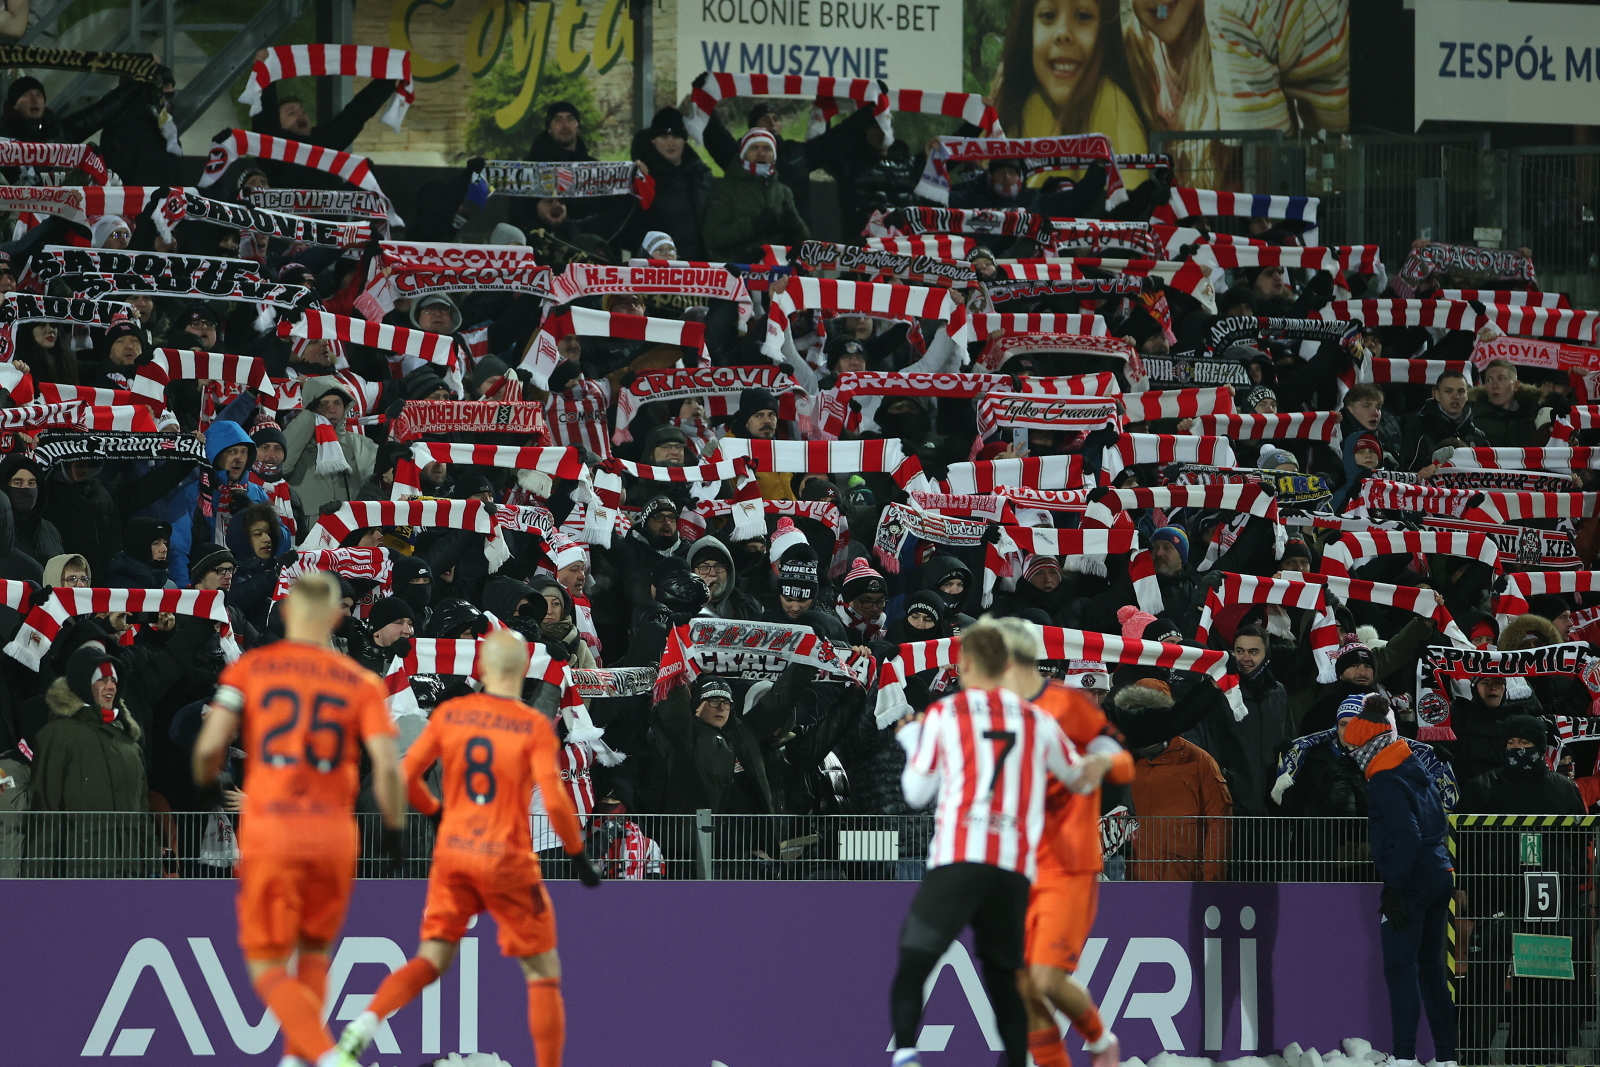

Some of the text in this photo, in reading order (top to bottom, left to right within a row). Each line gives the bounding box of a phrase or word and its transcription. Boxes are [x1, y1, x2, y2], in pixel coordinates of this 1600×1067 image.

[702, 0, 939, 31] KOLONIE BRUK-BET
[701, 41, 889, 79] W MUSZYNIE
[1438, 35, 1600, 82] ZESPÓŁ M
[945, 137, 1109, 157] TARNOVIA
[85, 151, 105, 173] 1906
[842, 244, 911, 272] Sportowy
[913, 255, 977, 281] Cracovia
[395, 267, 552, 292] CRACOVIA
[585, 267, 728, 288] K.S. CRACOVIA
[987, 276, 1143, 304] CRACOVIA
[629, 367, 795, 396] CRACOVIA
[839, 374, 1013, 392] CRACOVIA
[408, 405, 497, 425] AMSTERDAM
[1000, 397, 1111, 424] Tylko Cracovia
[453, 424, 497, 433] CHAMPIONS
[696, 499, 840, 528] CROVIA
[781, 585, 811, 599] 19 10
[261, 688, 348, 773] 25
[465, 736, 497, 806] 8
[982, 730, 1016, 792] 7
[1537, 882, 1550, 912] 5
